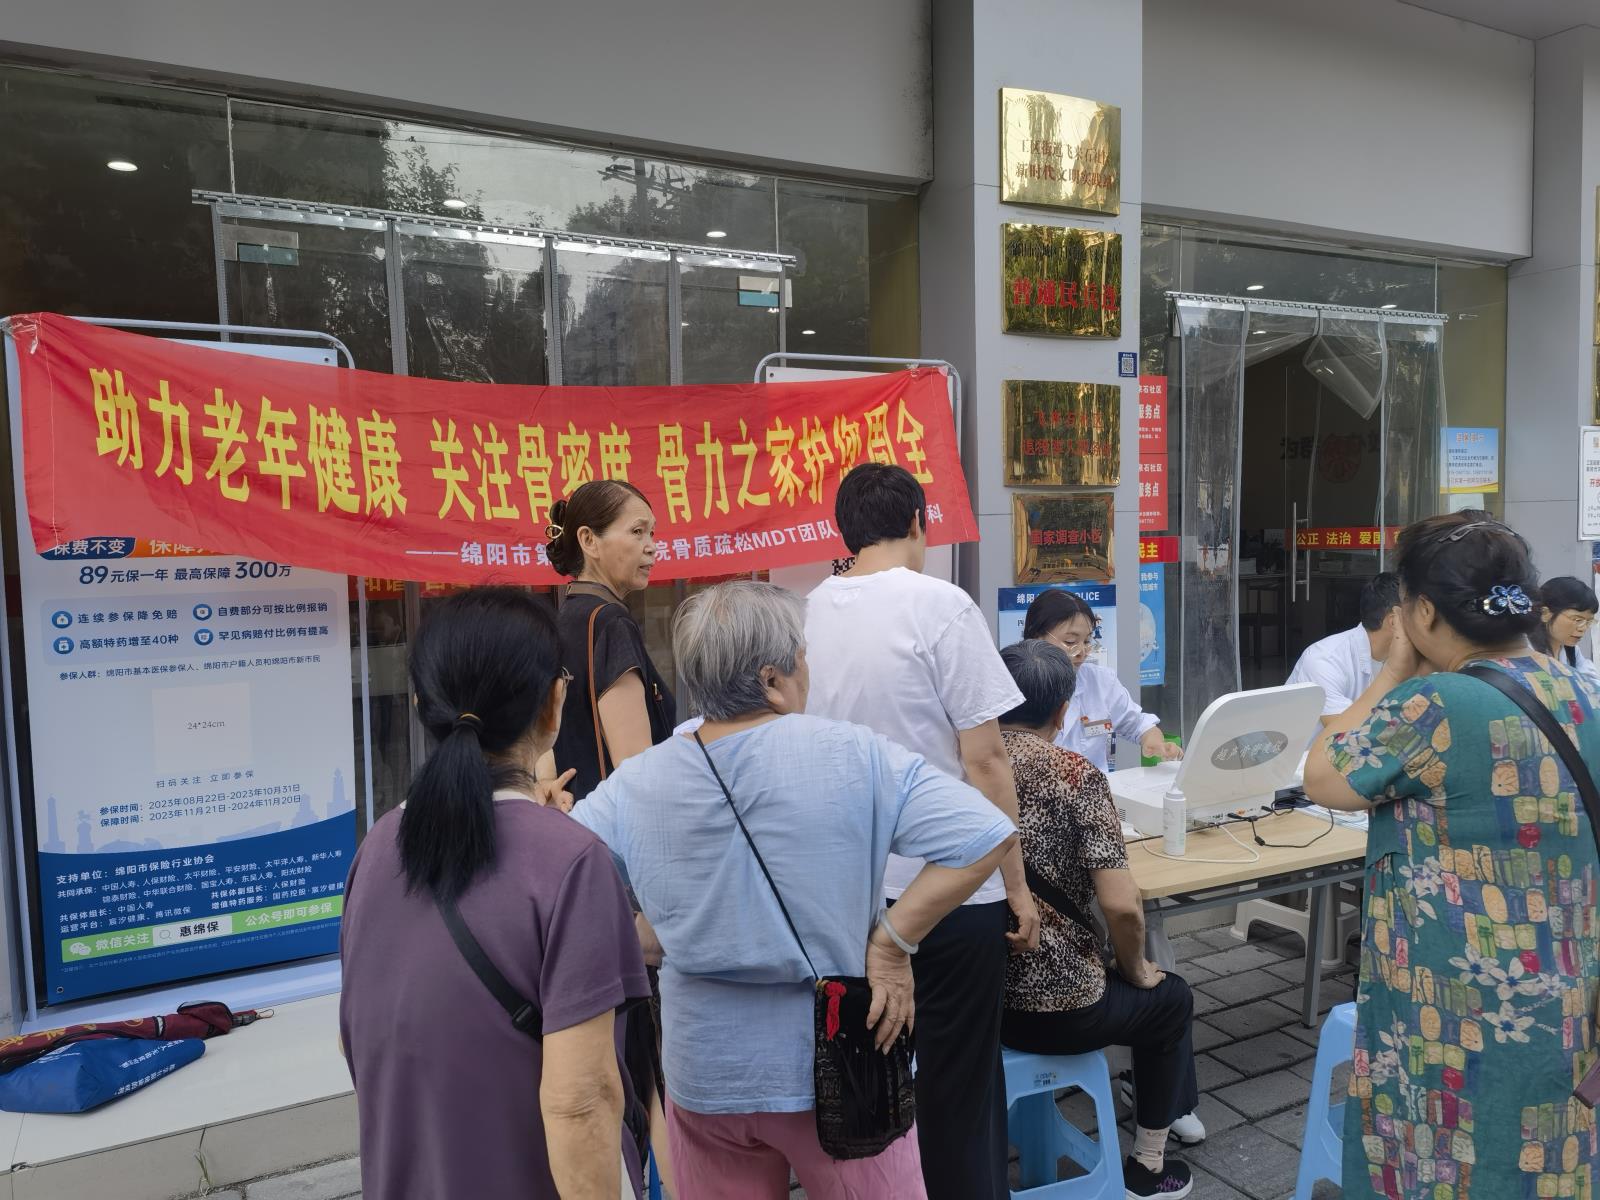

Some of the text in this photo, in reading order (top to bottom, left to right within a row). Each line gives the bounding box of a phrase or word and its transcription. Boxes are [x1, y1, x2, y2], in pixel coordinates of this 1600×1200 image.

[89, 368, 934, 525] 助力老年健康 关注骨密度 骨力之家护您周全
[926, 503, 944, 524] 科
[1296, 532, 1320, 545] 公正
[1326, 531, 1352, 545] 法治
[1360, 531, 1386, 545] 爱国
[54, 540, 126, 556] 保费不变
[79, 560, 292, 585] 89元保一年 最高保障 300万
[77, 608, 178, 625] 连续参保降免赔
[218, 602, 328, 617] 自费部分可按比例报销
[79, 633, 179, 650] 高额特药增至40种
[218, 625, 329, 641] 罕见病赔付比例有提高
[156, 770, 255, 789] 扫码关注 立即参保
[95, 933, 150, 951] 微信关注
[179, 921, 219, 938] 惠绵保
[245, 902, 333, 927] 公众号即可参保
